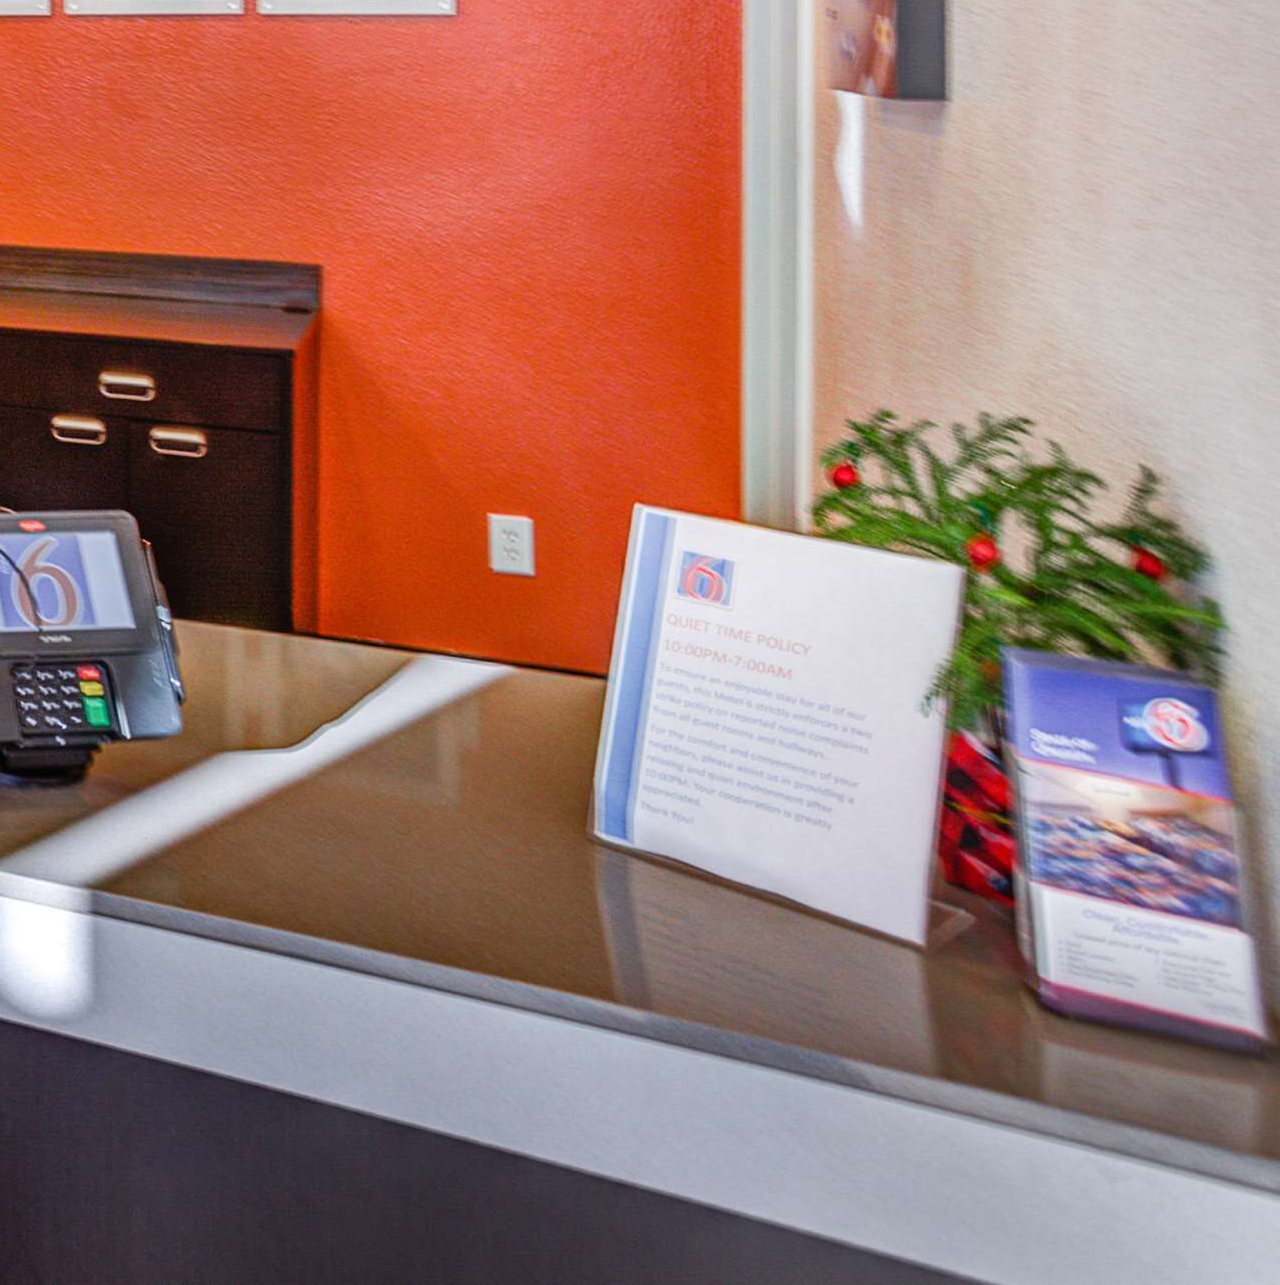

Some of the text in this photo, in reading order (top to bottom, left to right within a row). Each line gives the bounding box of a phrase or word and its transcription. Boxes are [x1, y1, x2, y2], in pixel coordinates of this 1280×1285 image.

[10, 536, 84, 628] 6
[666, 613, 812, 656] QUIET TIME POLICY
[664, 639, 793, 679] 10:00PM-7:00AM
[684, 699, 713, 716] policy
[730, 710, 777, 730] reported
[777, 692, 797, 706] stay
[799, 699, 816, 708] for
[818, 702, 831, 713] all
[679, 712, 691, 721] all
[692, 716, 720, 731] guest
[756, 733, 777, 745] and
[668, 728, 685, 740] the
[687, 734, 727, 753] comfort
[729, 746, 749, 759] and
[834, 775, 860, 789] your
[686, 763, 707, 776] and
